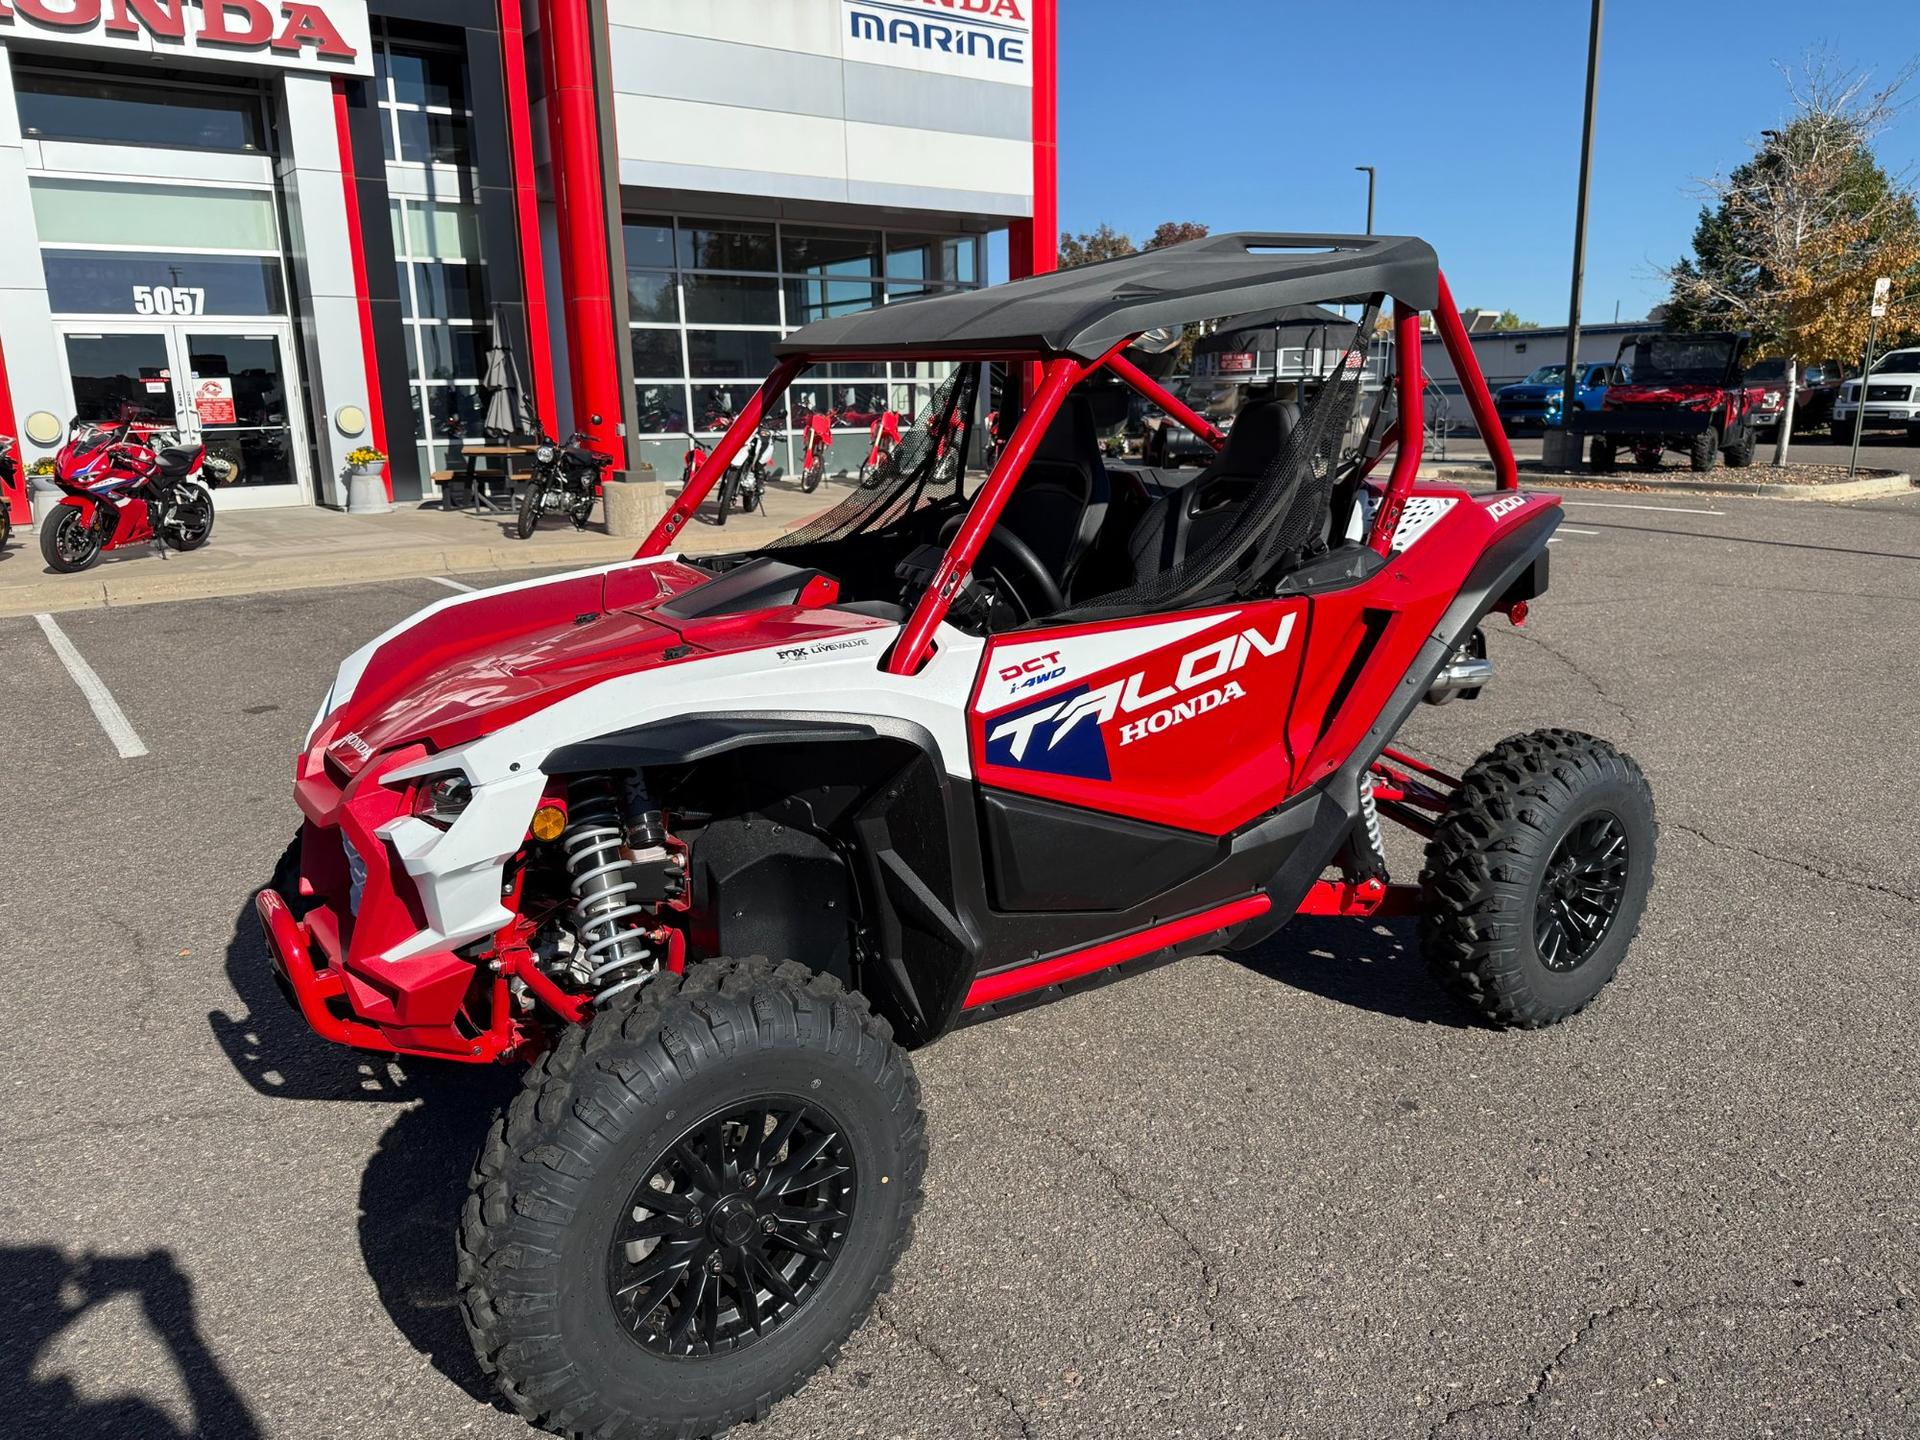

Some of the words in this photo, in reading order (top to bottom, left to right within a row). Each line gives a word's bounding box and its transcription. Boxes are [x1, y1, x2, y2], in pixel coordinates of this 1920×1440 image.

[133, 285, 205, 316] 5057
[776, 647, 808, 662] FOX
[998, 650, 1060, 682] DCT
[988, 611, 1297, 762] TALON
[1009, 666, 1066, 694] i-4WD
[1119, 680, 1247, 747] HONDA
